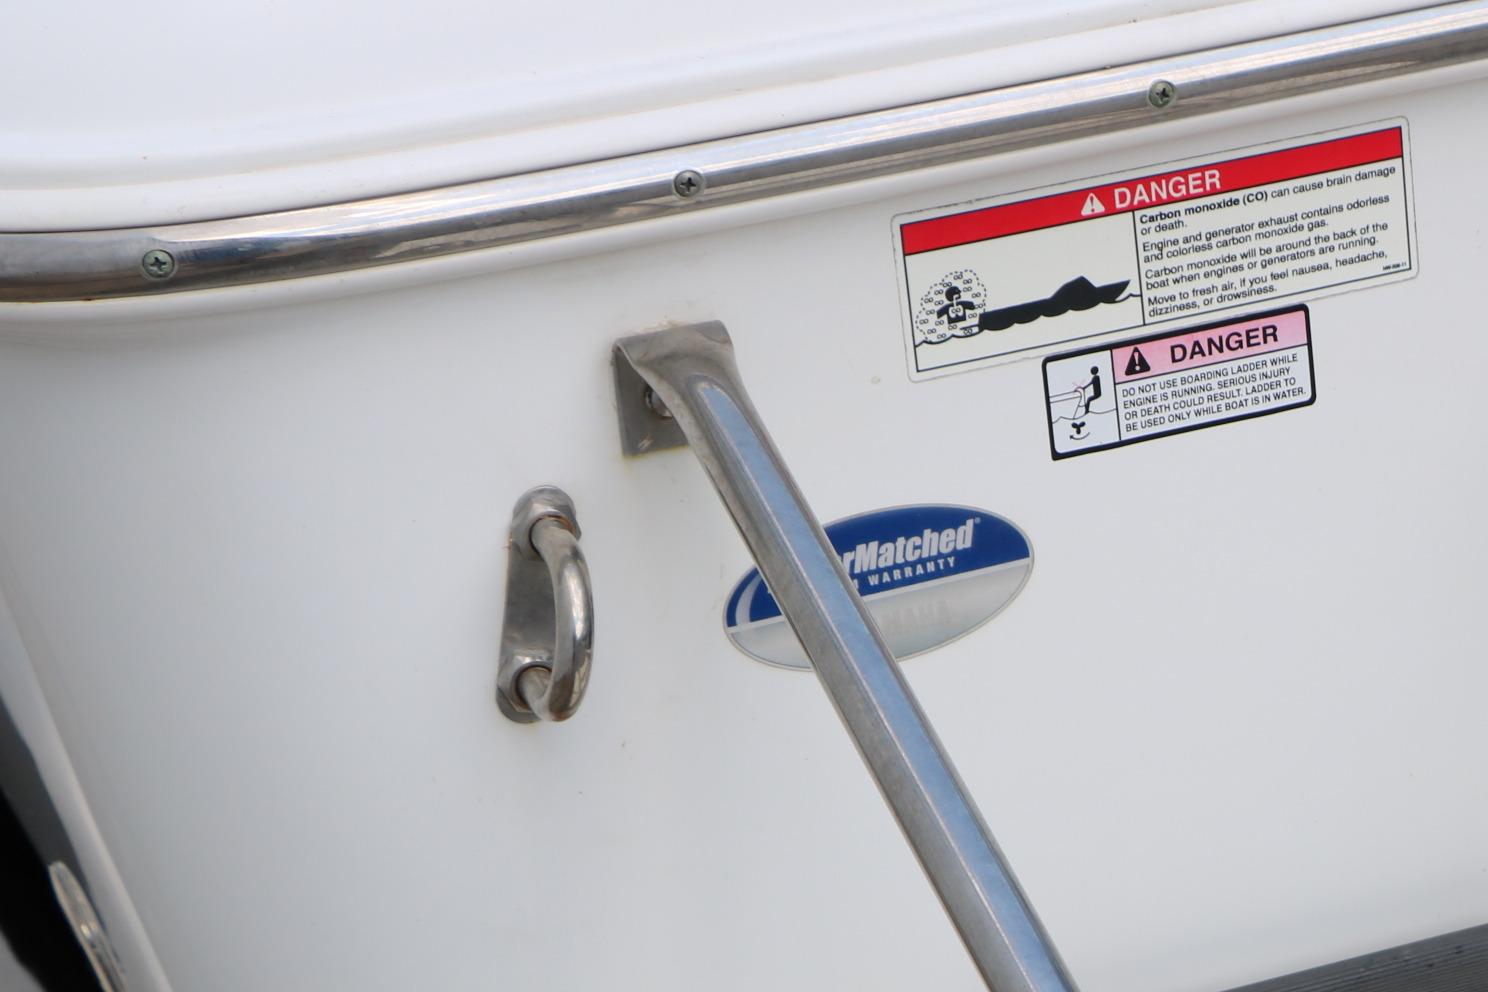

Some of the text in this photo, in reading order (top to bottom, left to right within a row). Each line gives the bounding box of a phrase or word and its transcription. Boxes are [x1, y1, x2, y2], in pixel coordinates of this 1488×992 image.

[1114, 169, 1221, 209] DANGER
[1139, 210, 1181, 224] Carbon
[1184, 197, 1240, 216] monoxide
[1271, 188, 1290, 198] can
[1292, 181, 1324, 194] cause
[1326, 175, 1352, 187] brain
[1354, 166, 1396, 181] damage
[1140, 226, 1152, 236] or
[1142, 195, 1390, 252] Engine and generator exhaust contains odorless
[1143, 250, 1164, 264] and
[1166, 242, 1213, 259] colorless
[1215, 234, 1252, 249] carbon
[1254, 223, 1305, 240] monoxide
[1145, 222, 1388, 279] Carbon monoxide will be around the back of the
[1145, 278, 1170, 291] boat
[1172, 272, 1201, 285] when
[1203, 264, 1245, 279] engines
[1247, 261, 1258, 270] or
[1260, 249, 1316, 270] generators
[1318, 245, 1335, 255] are
[1147, 294, 1176, 307] Move
[1179, 291, 1190, 300] to
[1192, 284, 1218, 297] fresh
[1240, 278, 1246, 288] if
[1248, 276, 1268, 288] you
[1270, 269, 1289, 281] feel
[1203, 297, 1213, 306] or
[1170, 325, 1278, 363] DANGER
[1122, 353, 1298, 398] DO NOT USE BOARDING LADDER WHILE
[1123, 394, 1158, 410] ENGINE
[1159, 392, 1169, 402] IS
[1217, 373, 1257, 390] SERIOUS
[1259, 366, 1290, 381] INJURY
[1124, 410, 1138, 421] OR
[1140, 403, 1171, 418] DEATH
[1172, 396, 1205, 411] COULD
[1245, 380, 1282, 396] LADDER
[1283, 376, 1296, 387] TO
[1125, 422, 1138, 432] BE
[1140, 416, 1166, 429] USED
[1167, 410, 1191, 423] ONLY
[1193, 404, 1223, 417] WHILE
[1224, 398, 1249, 411] BOAT
[1251, 396, 1260, 406] IS
[1262, 394, 1271, 403] IN
[868, 556, 956, 586] WARRANTY
